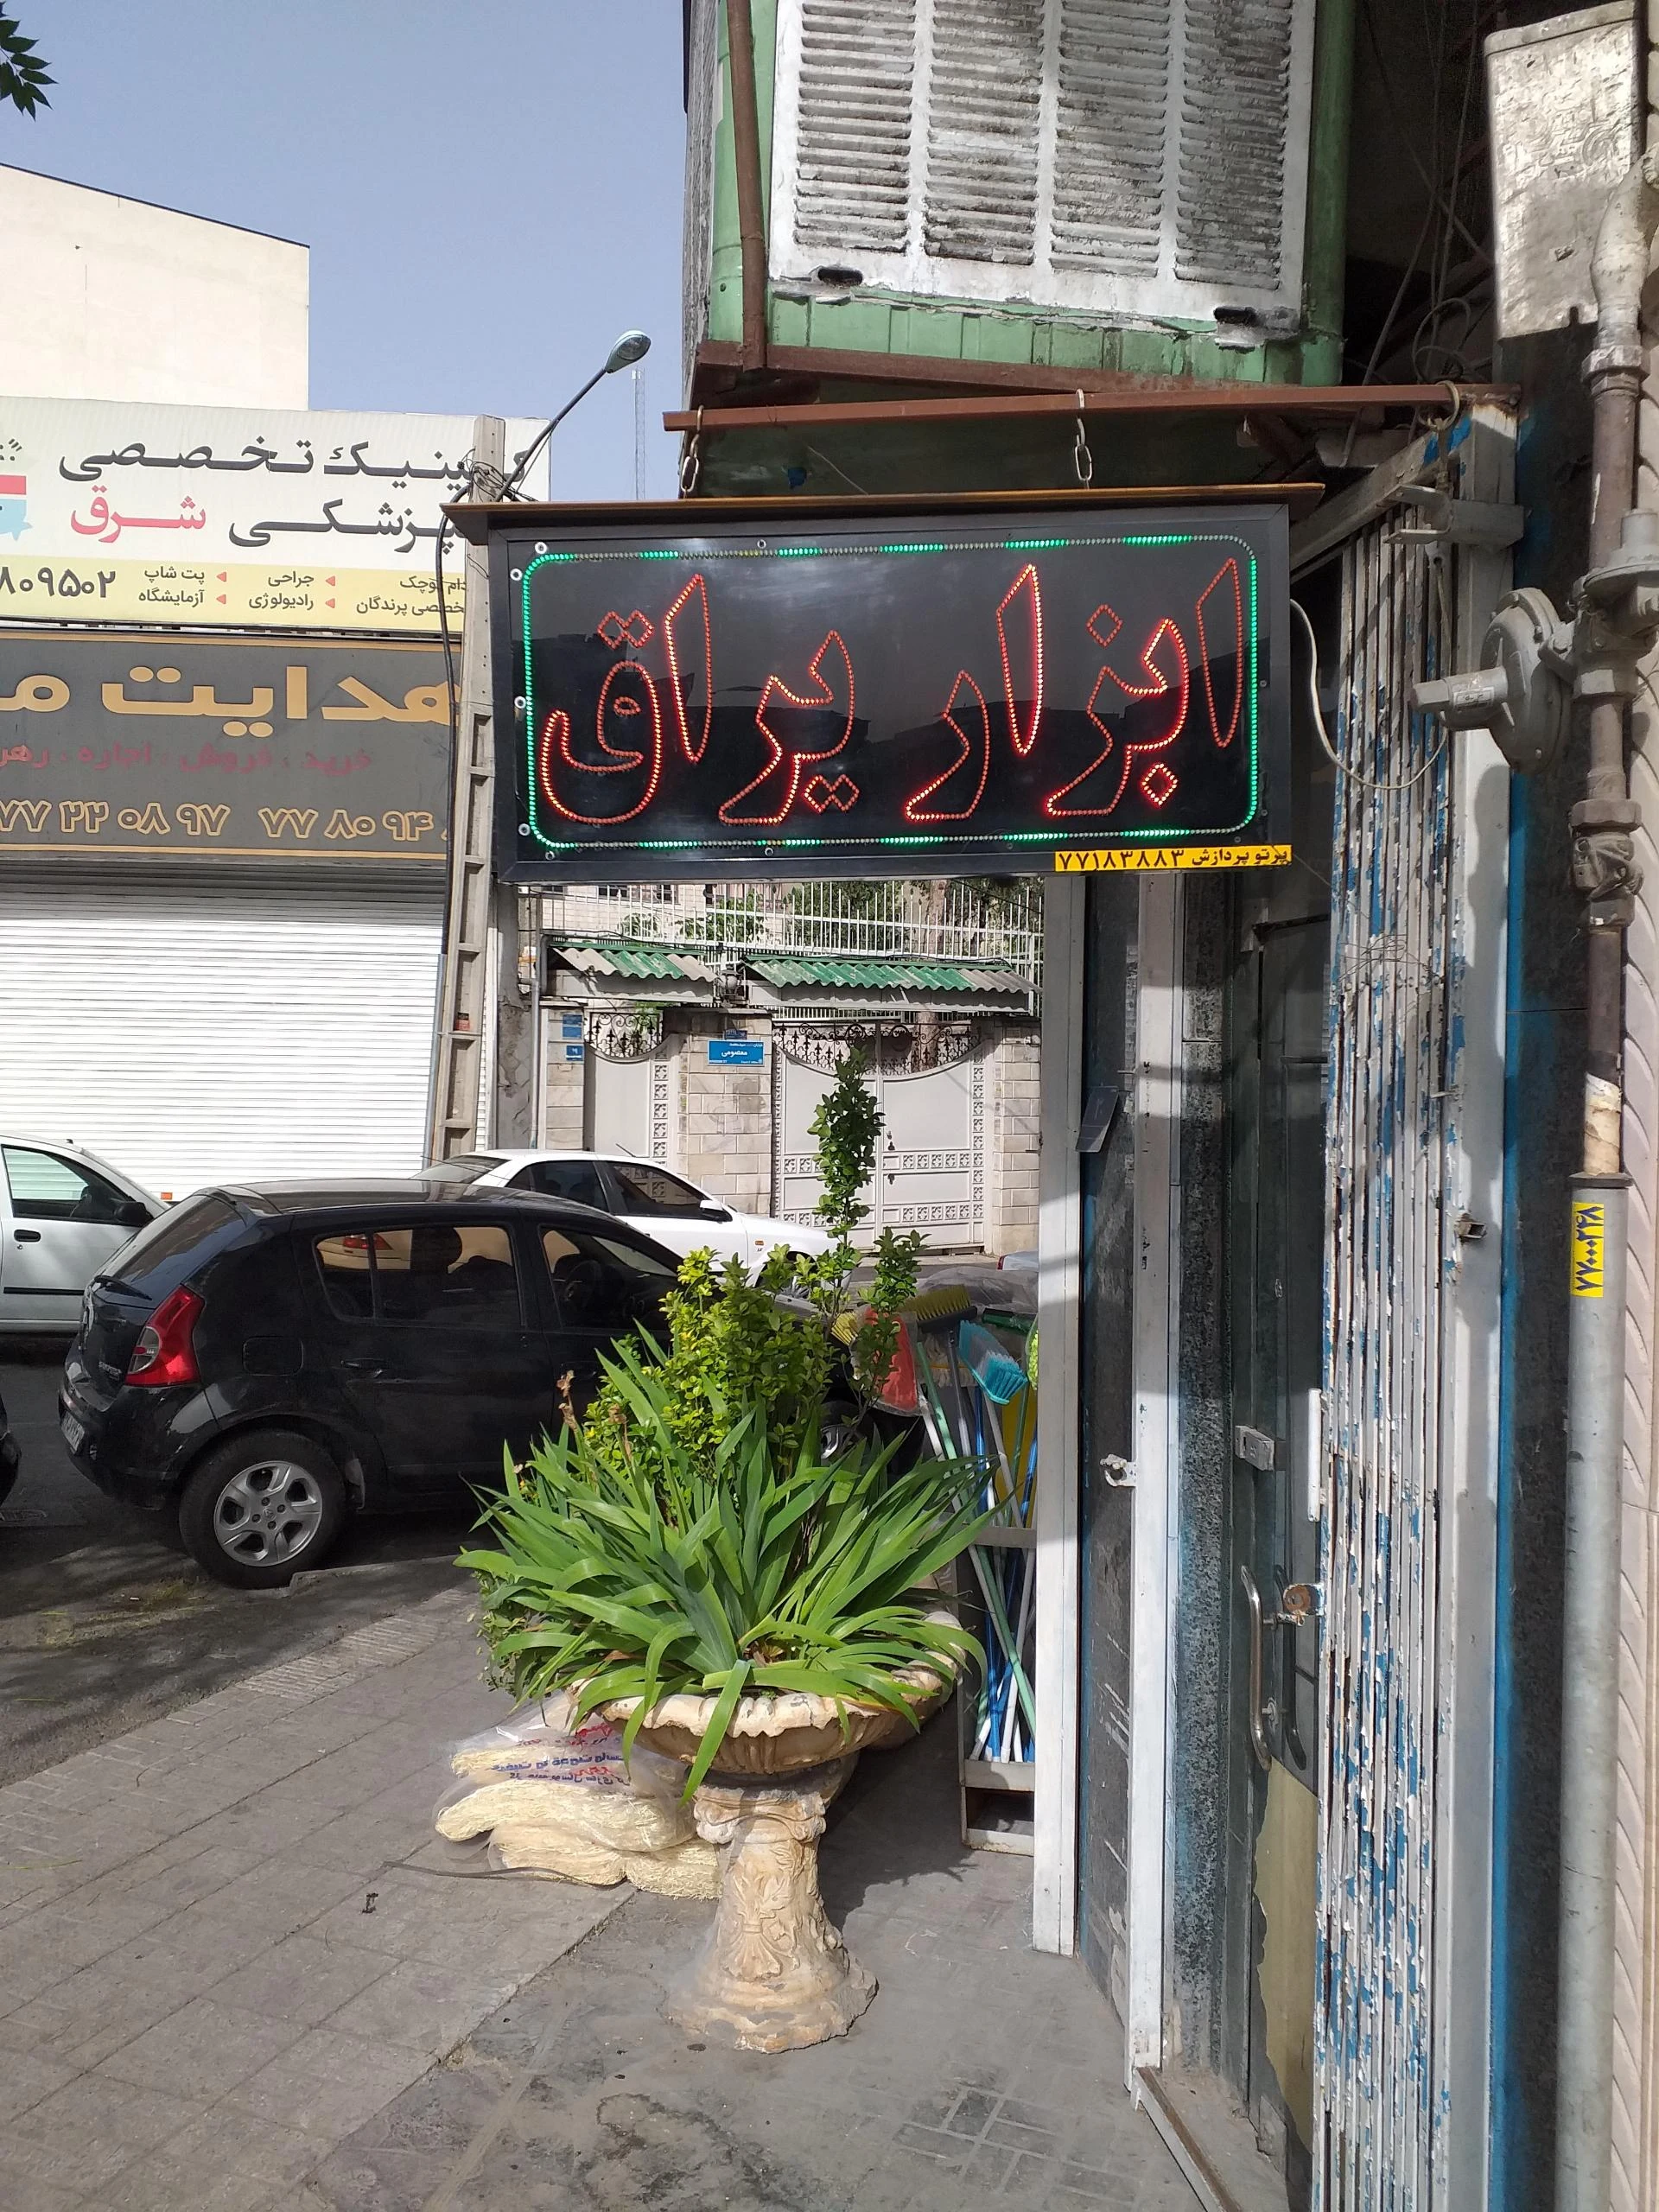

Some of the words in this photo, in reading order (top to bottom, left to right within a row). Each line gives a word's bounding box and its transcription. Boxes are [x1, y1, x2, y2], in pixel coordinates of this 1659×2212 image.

[59, 435, 314, 482] تخصصی
[323, 440, 526, 488] کینیک
[70, 484, 207, 543] شرق
[144, 565, 177, 583] شاپ
[181, 569, 205, 585] پت
[268, 571, 315, 588] جراحی
[399, 575, 439, 594] وچک
[138, 589, 205, 608] آزمایشگاه
[248, 593, 315, 610] رادیولوژی
[356, 595, 408, 616] پرندگان
[540, 573, 859, 823] یراق
[905, 556, 1244, 821] ابزار
[101, 665, 461, 738] هدایت
[78, 741, 151, 771] اجاره
[59, 800, 109, 835] ۲۲
[1058, 849, 1185, 870] ۷۷۱۸۳۸۸۳
[1192, 848, 1249, 867] پردازش
